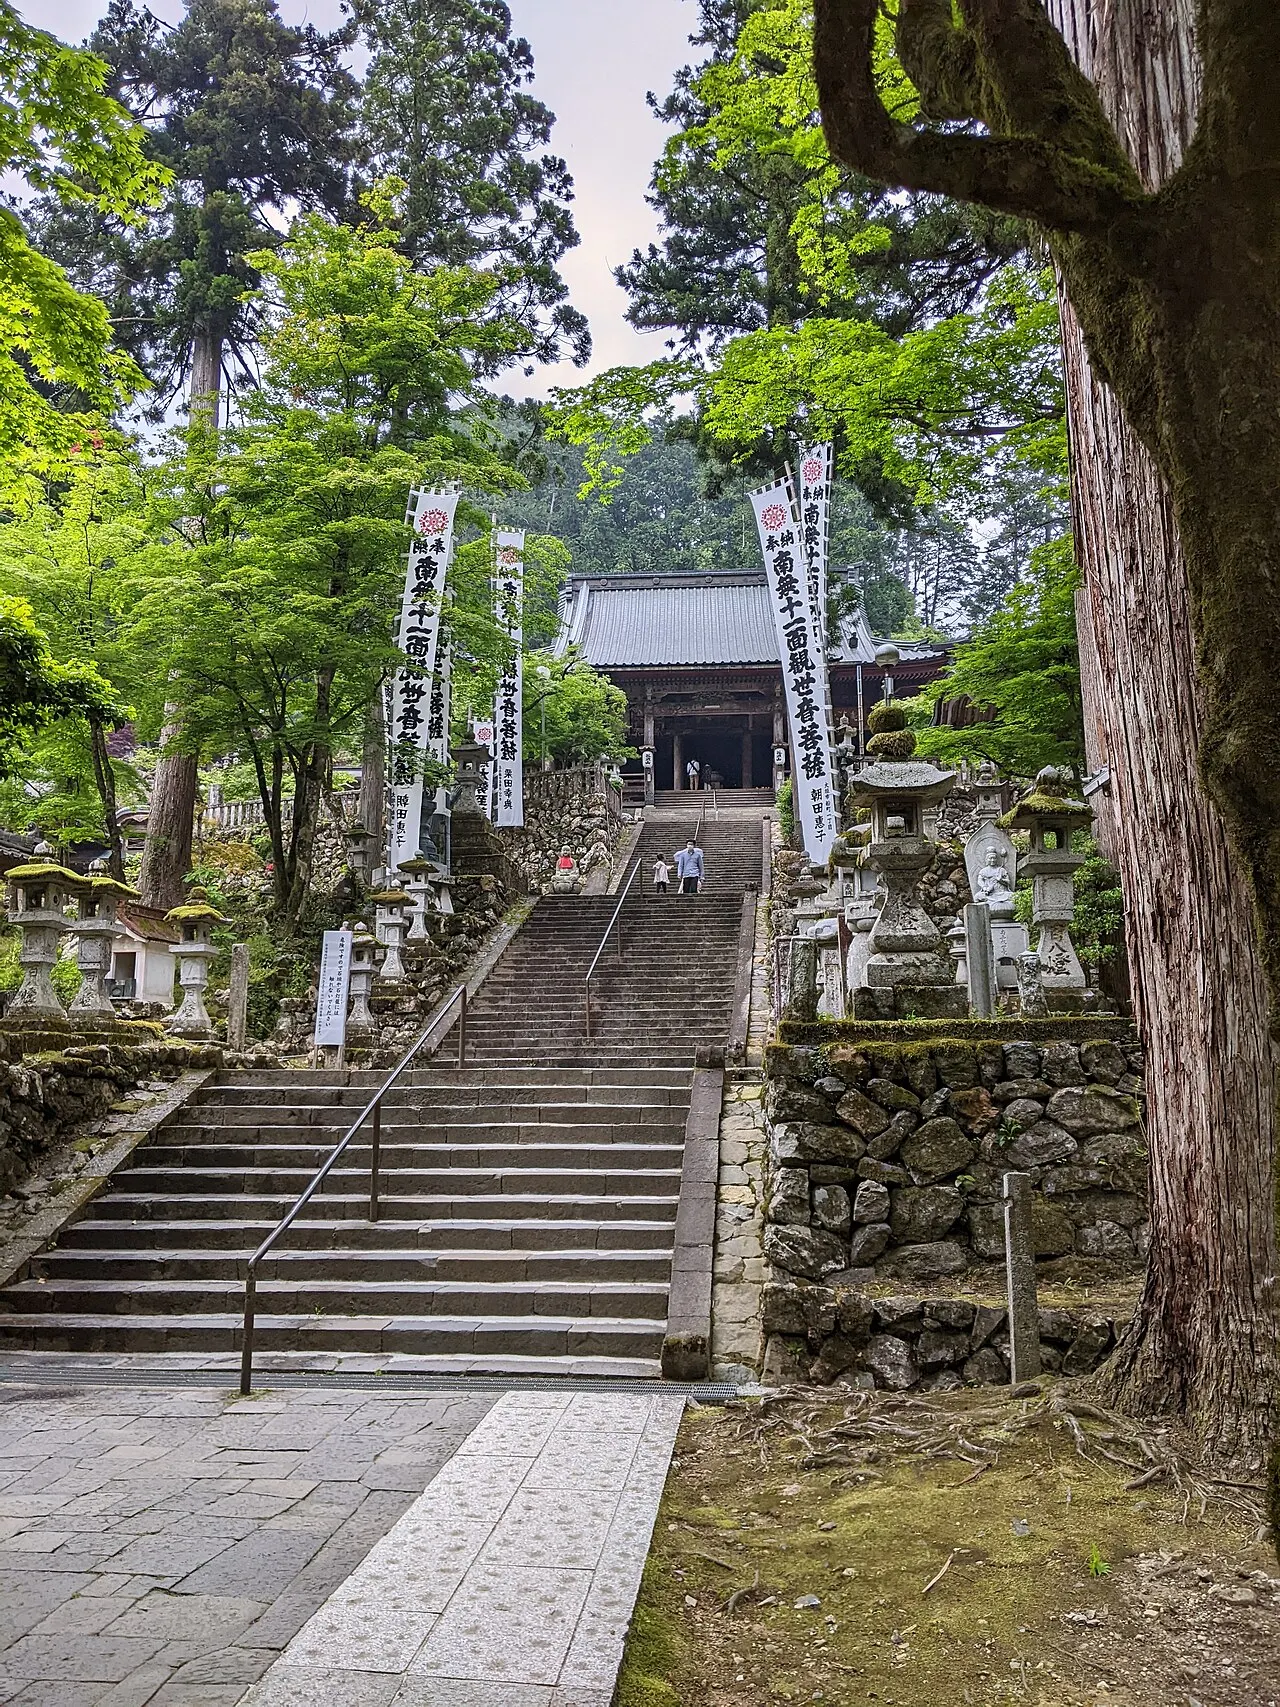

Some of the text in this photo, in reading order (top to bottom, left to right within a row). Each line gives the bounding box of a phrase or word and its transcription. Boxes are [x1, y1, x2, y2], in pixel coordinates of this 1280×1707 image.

[803, 485, 824, 502] 奉納
[765, 529, 794, 552] 奉納
[773, 550, 826, 781] 南無十一面観世音菩薩
